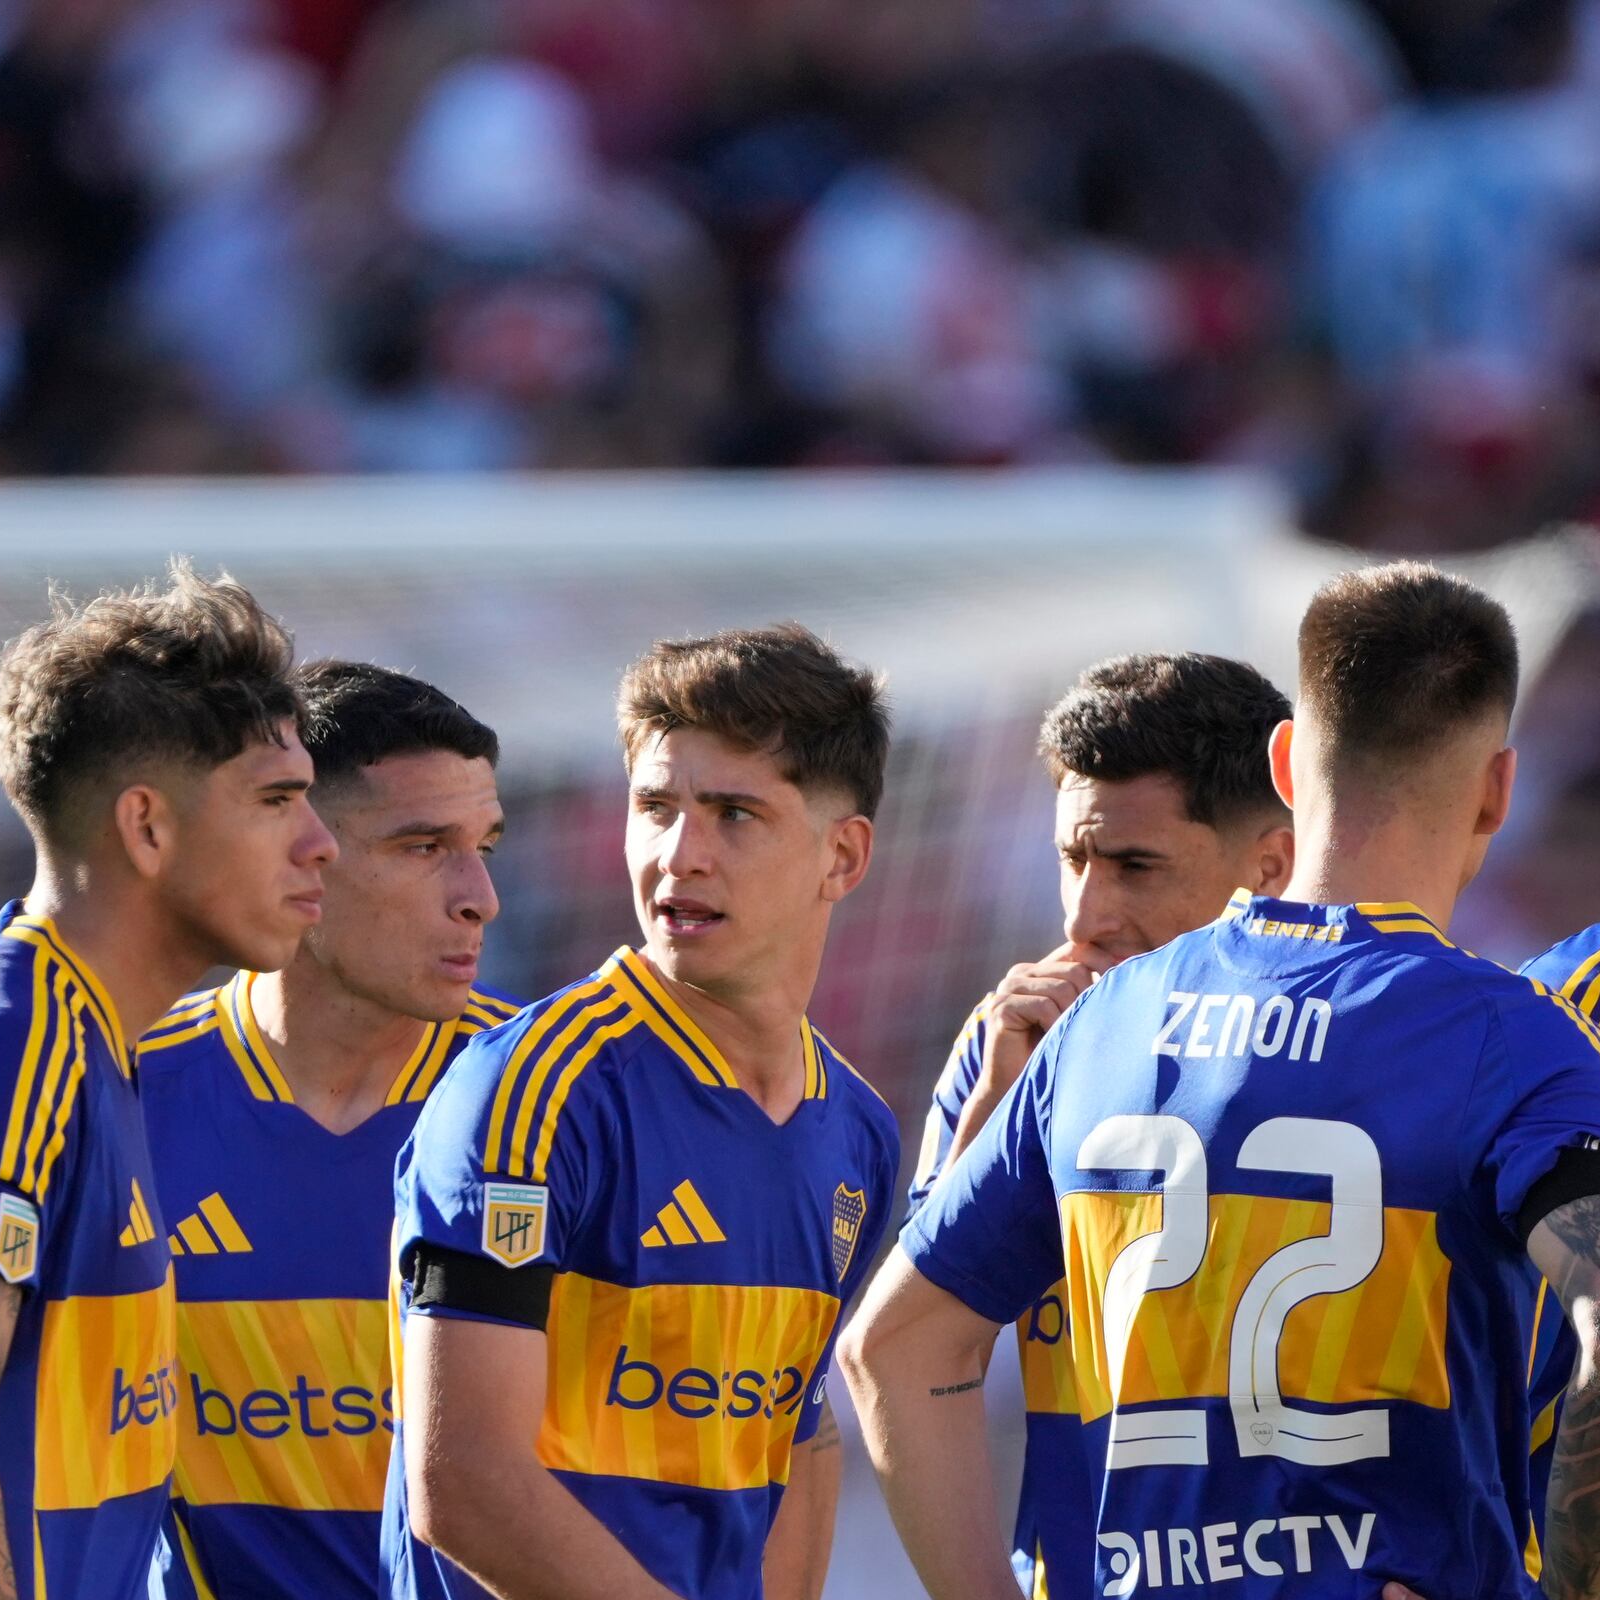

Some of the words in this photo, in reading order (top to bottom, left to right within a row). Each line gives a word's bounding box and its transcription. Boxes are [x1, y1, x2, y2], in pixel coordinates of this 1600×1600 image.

[1248, 919, 1344, 942] XENEIZE
[1151, 991, 1331, 1062] ZENON
[1076, 1114, 1389, 1469] 22
[1097, 1513, 1376, 1597] DIRECTV
